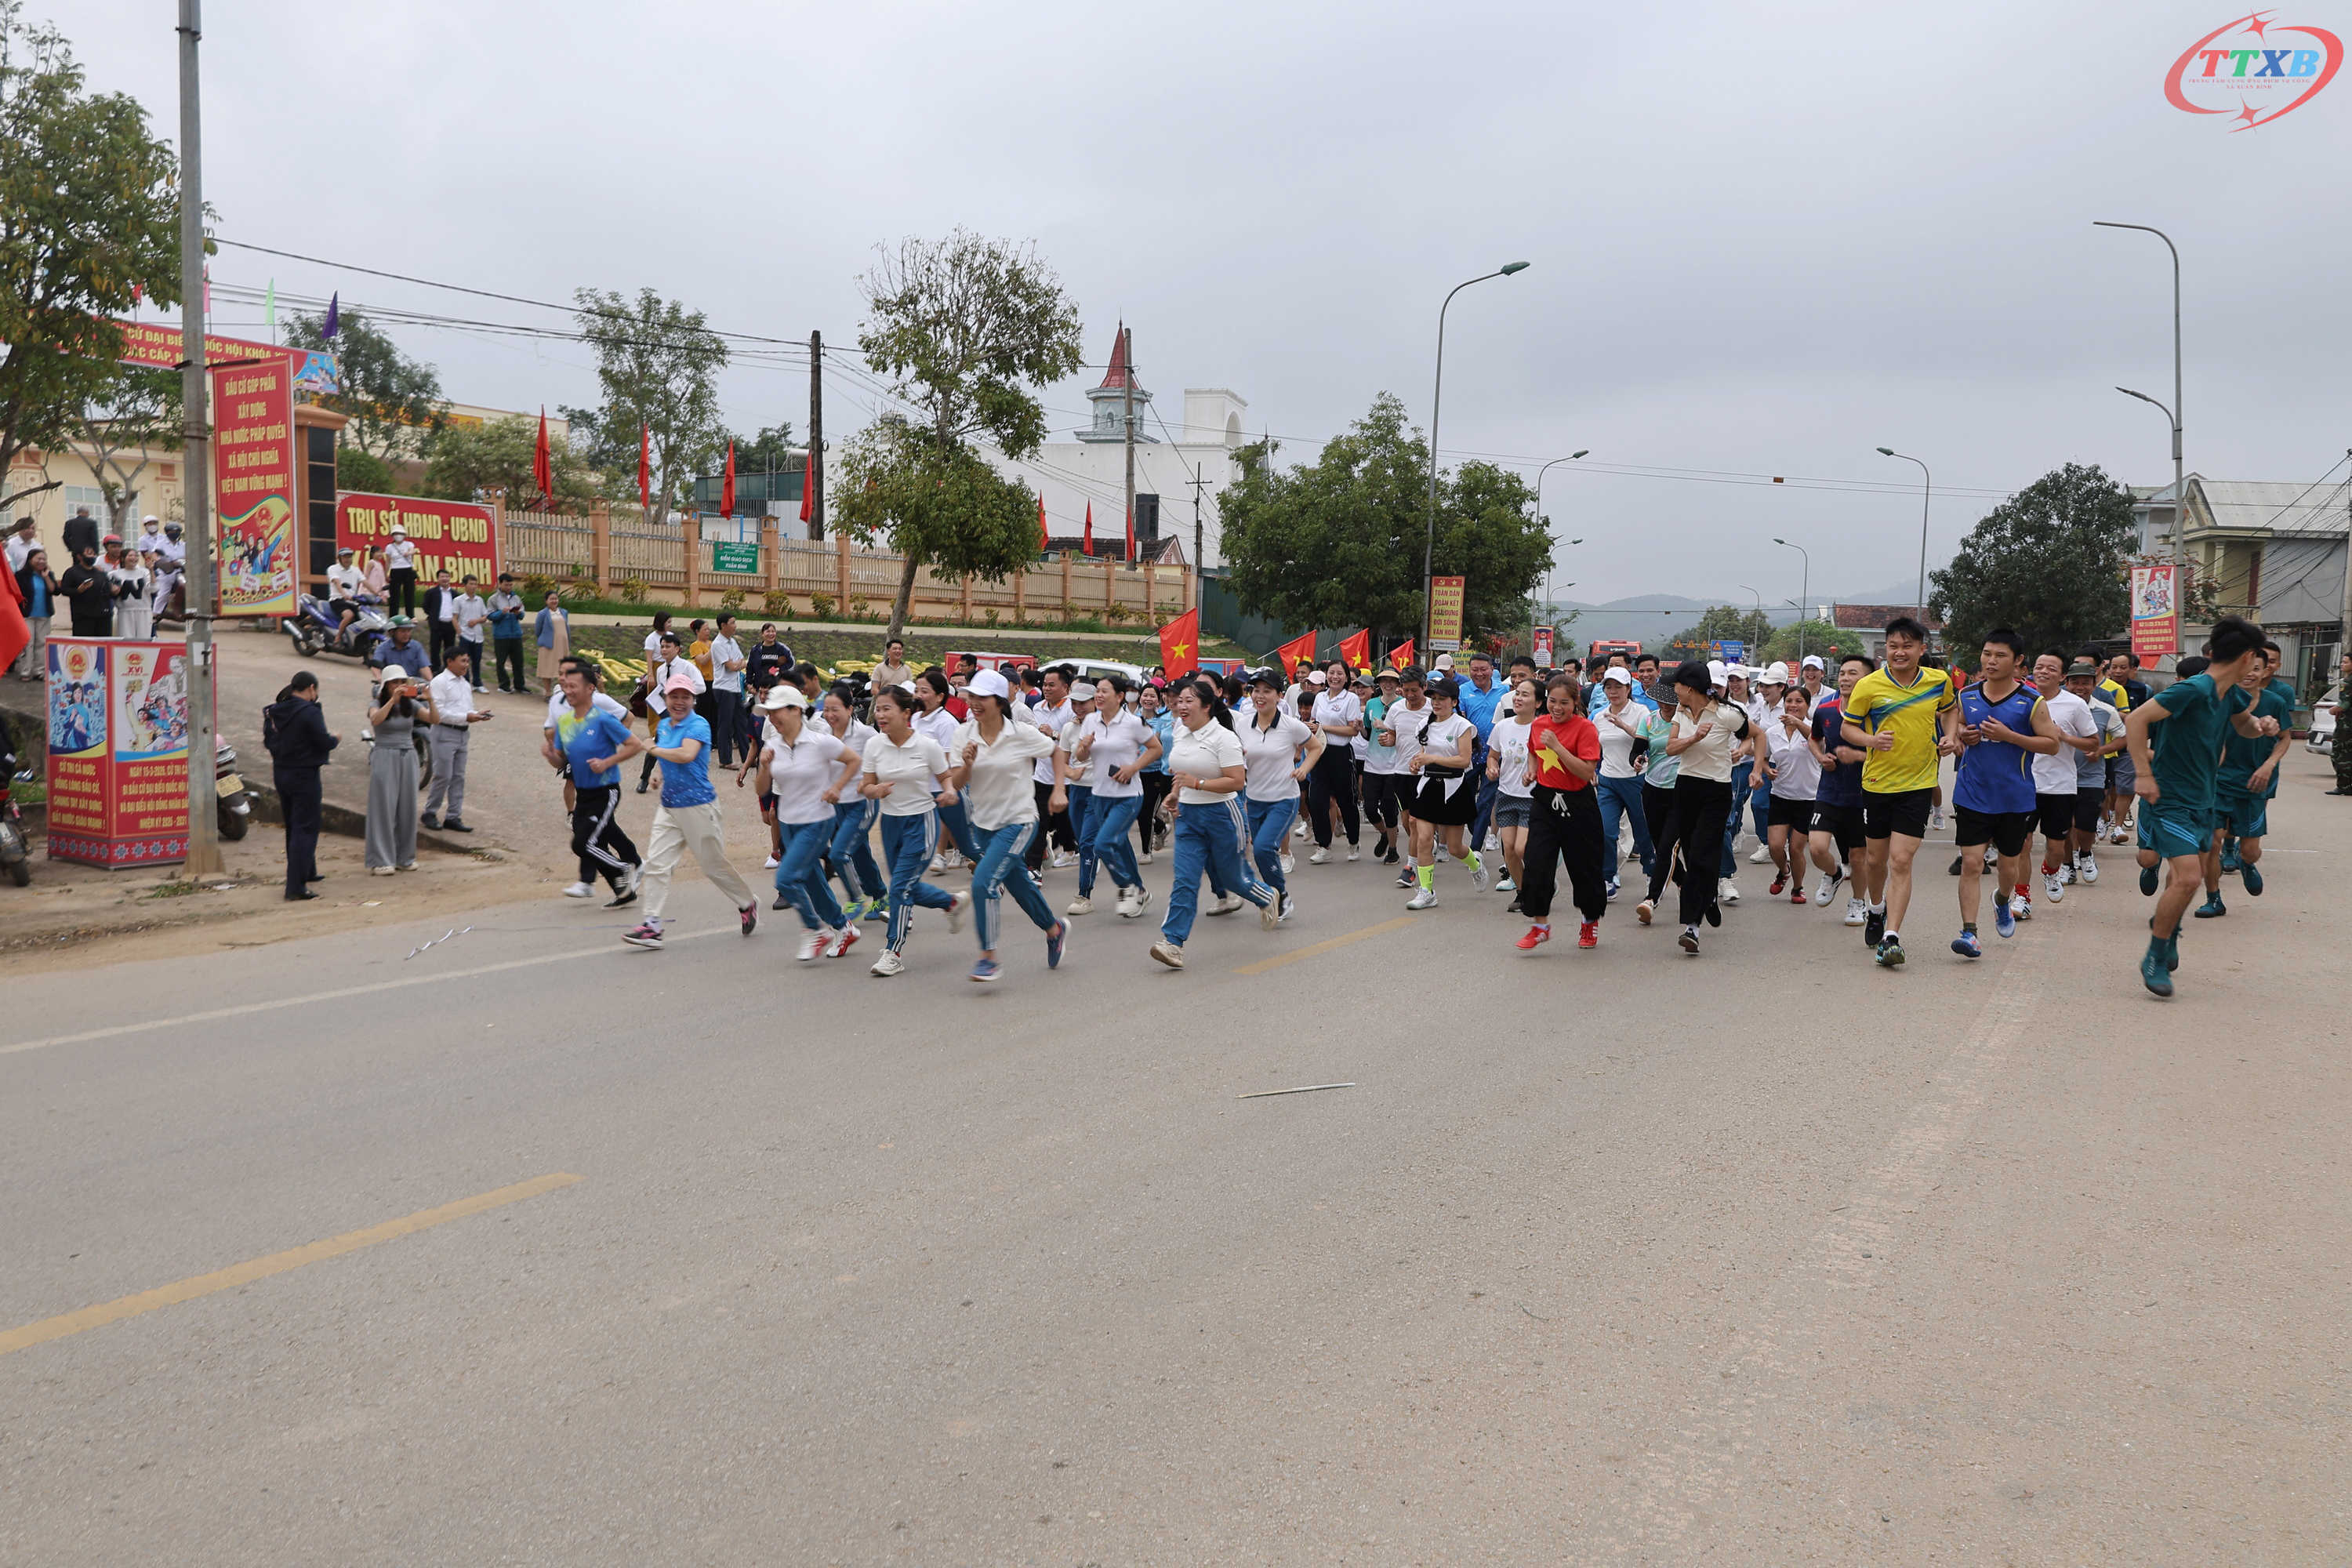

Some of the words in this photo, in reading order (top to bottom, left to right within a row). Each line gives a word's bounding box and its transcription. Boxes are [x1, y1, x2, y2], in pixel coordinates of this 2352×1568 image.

[127, 325, 143, 340] CỬ
[145, 331, 165, 345] ĐẠI
[225, 343, 243, 358] HỘI
[149, 347, 173, 363] CẤP,
[238, 375, 247, 395] CỬ
[247, 376, 260, 393] GÓP
[238, 401, 249, 419] XÂY
[250, 401, 267, 420] DỰNG
[220, 427, 233, 446] NHÀ
[233, 426, 249, 445] NƯỚC
[250, 424, 266, 443] PHÁP
[267, 420, 286, 442] QUYỀN
[228, 451, 237, 469] XÃ
[237, 450, 248, 470] HỘI
[248, 446, 260, 466] CHỦ
[261, 447, 280, 466] NGHĨA
[222, 476, 234, 496] VIỆT
[234, 477, 249, 492] NAM
[249, 474, 265, 491] VỮNG
[265, 474, 284, 492] MẠNH
[347, 506, 376, 541] TRỤ
[379, 500, 400, 536] SỞ
[445, 550, 492, 585] BÌNH
[1449, 598, 1459, 607] KẾT
[1443, 617, 1457, 626] SỐNG
[1810, 812, 1822, 826] 11
